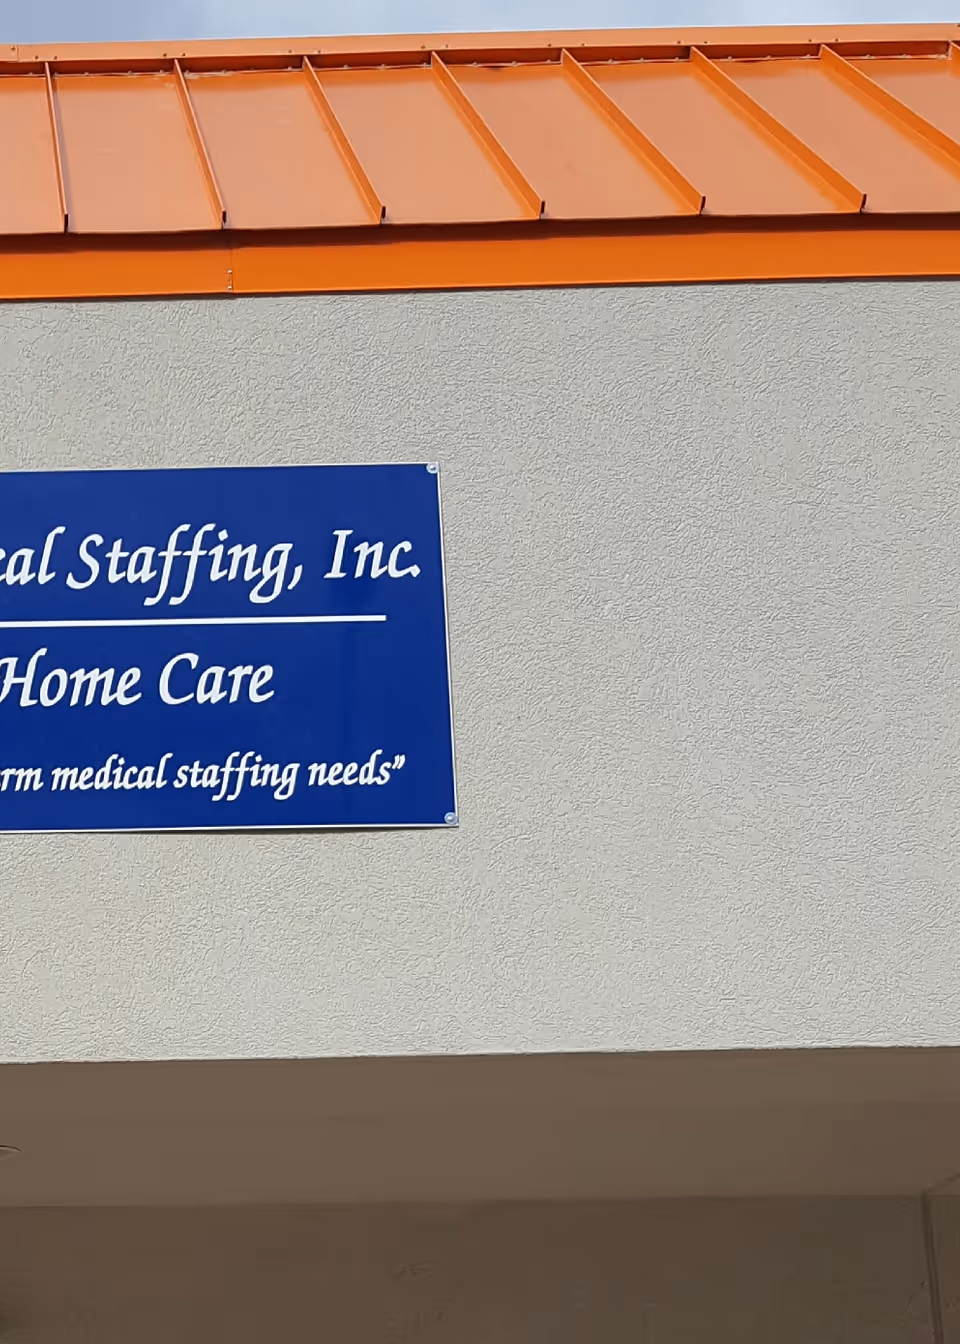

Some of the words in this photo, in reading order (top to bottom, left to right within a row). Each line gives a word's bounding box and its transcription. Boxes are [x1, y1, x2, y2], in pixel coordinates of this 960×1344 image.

[65, 523, 303, 606] Staffing,
[323, 529, 421, 580] Inc.
[159, 652, 275, 705] Care
[51, 752, 174, 791] medical
[172, 750, 301, 802] staffing
